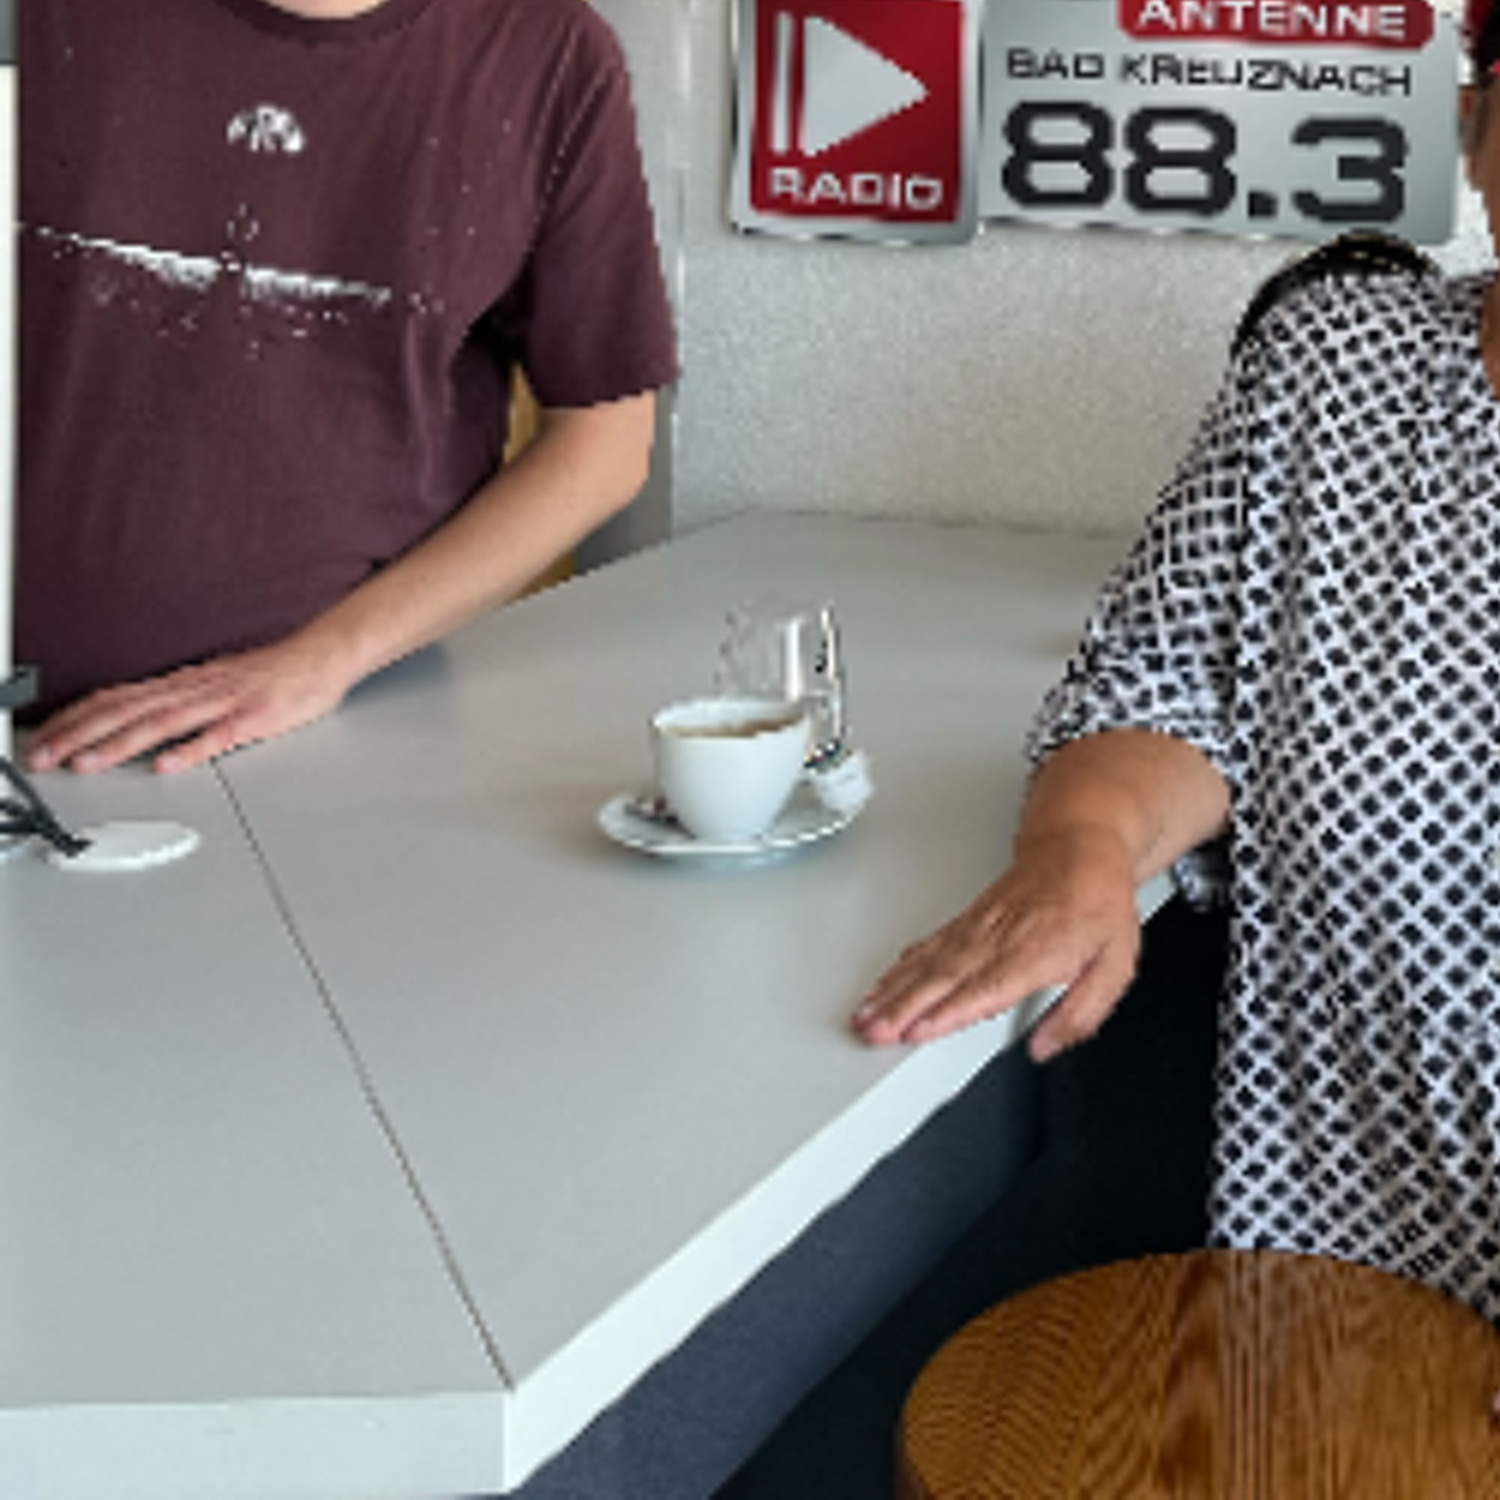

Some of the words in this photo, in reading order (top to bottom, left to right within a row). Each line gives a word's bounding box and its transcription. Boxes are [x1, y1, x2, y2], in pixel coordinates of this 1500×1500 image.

[1008, 49, 1103, 79] BAD
[1121, 54, 1411, 96] KREUZNACH
[1001, 100, 1409, 223] 88.3
[770, 168, 943, 210] RADIO
